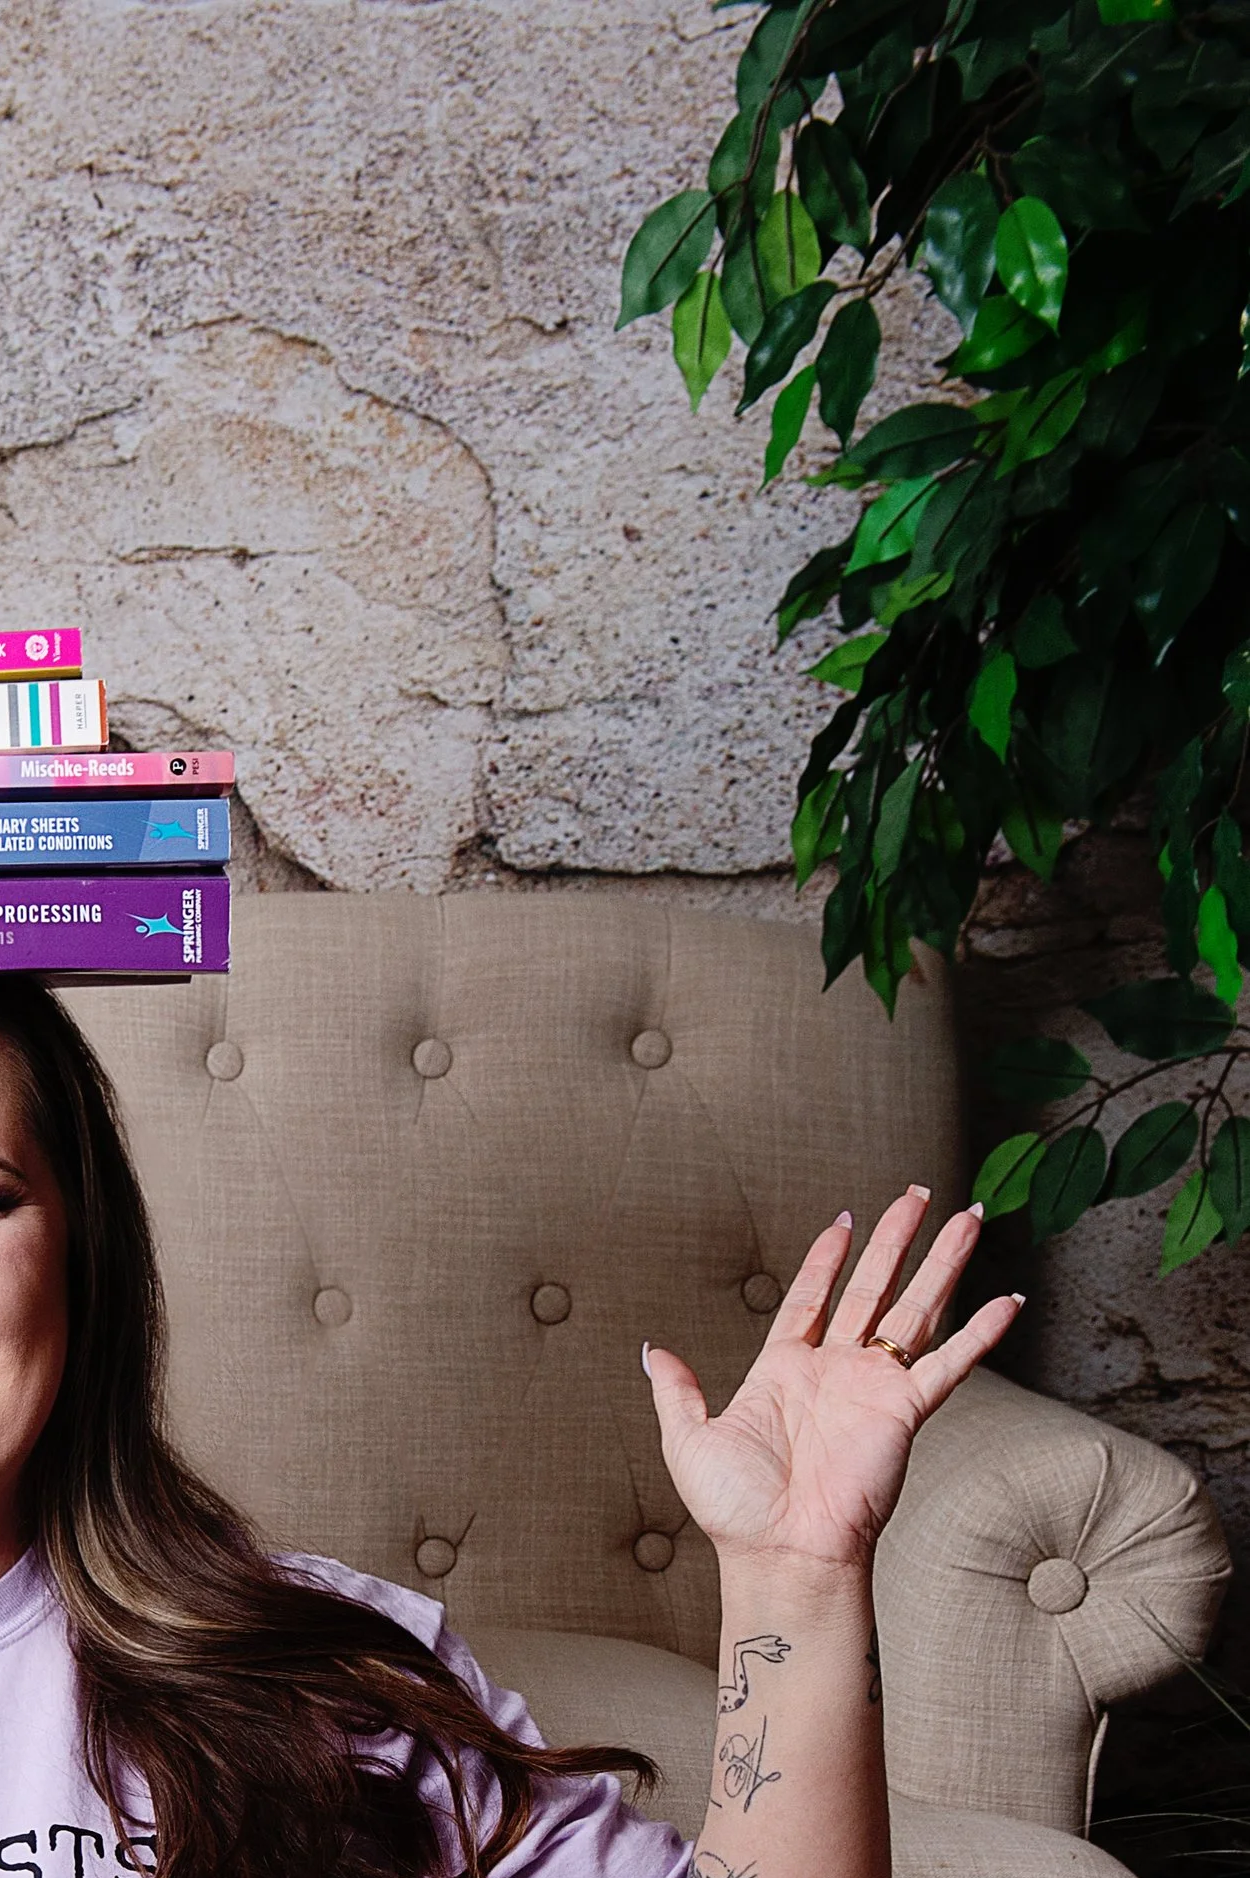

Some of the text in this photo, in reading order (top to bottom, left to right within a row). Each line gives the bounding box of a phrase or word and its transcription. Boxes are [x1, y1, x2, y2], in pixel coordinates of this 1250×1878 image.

[75, 693, 84, 730] HARPER
[20, 758, 135, 779] Mischke-Reeds
[192, 757, 200, 776] PESI
[30, 816, 80, 834] SHEETS
[38, 835, 114, 851] CONDITIONS
[182, 888, 196, 964] SPRINGER
[194, 888, 203, 964] PUBLISHING COMPANY
